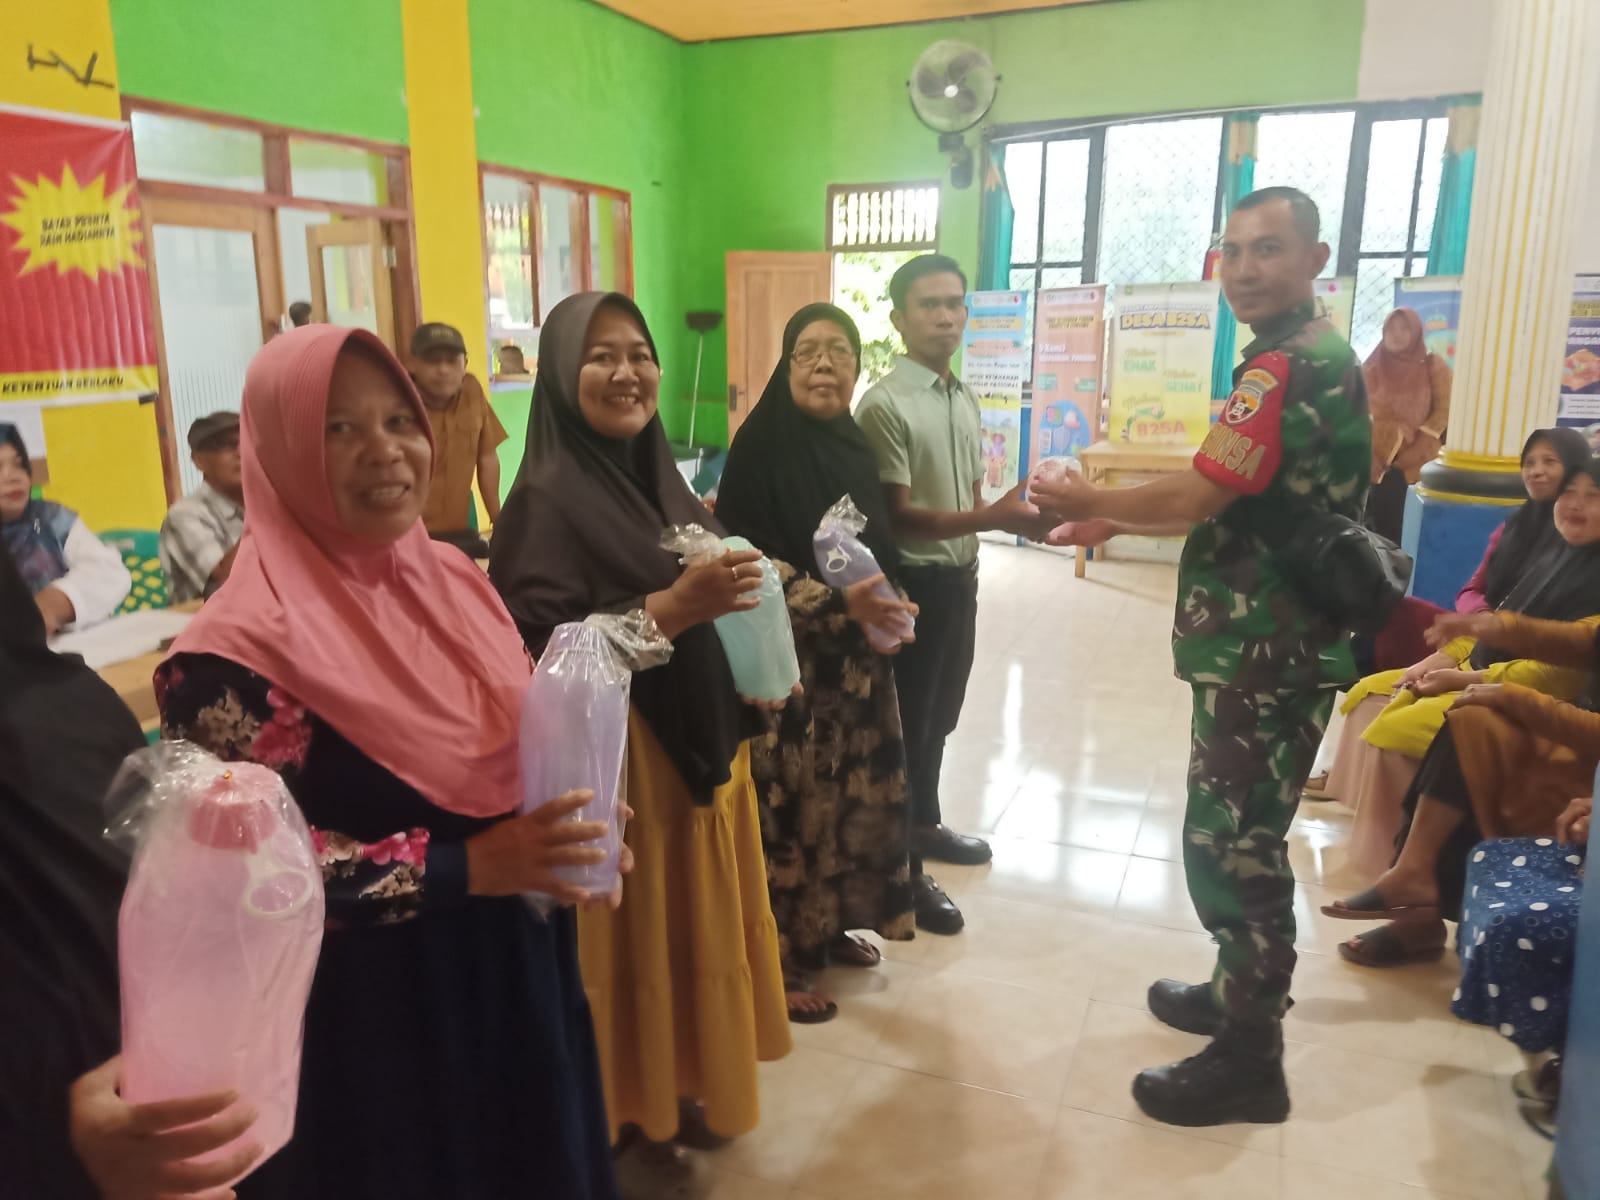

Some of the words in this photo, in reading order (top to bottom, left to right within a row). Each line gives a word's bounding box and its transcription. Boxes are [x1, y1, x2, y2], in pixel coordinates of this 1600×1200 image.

[1119, 313, 1166, 331] DESA
[1165, 312, 1211, 330] B2SA
[2, 380, 73, 393] KETENTUAN
[1136, 420, 1187, 437] B2SA
